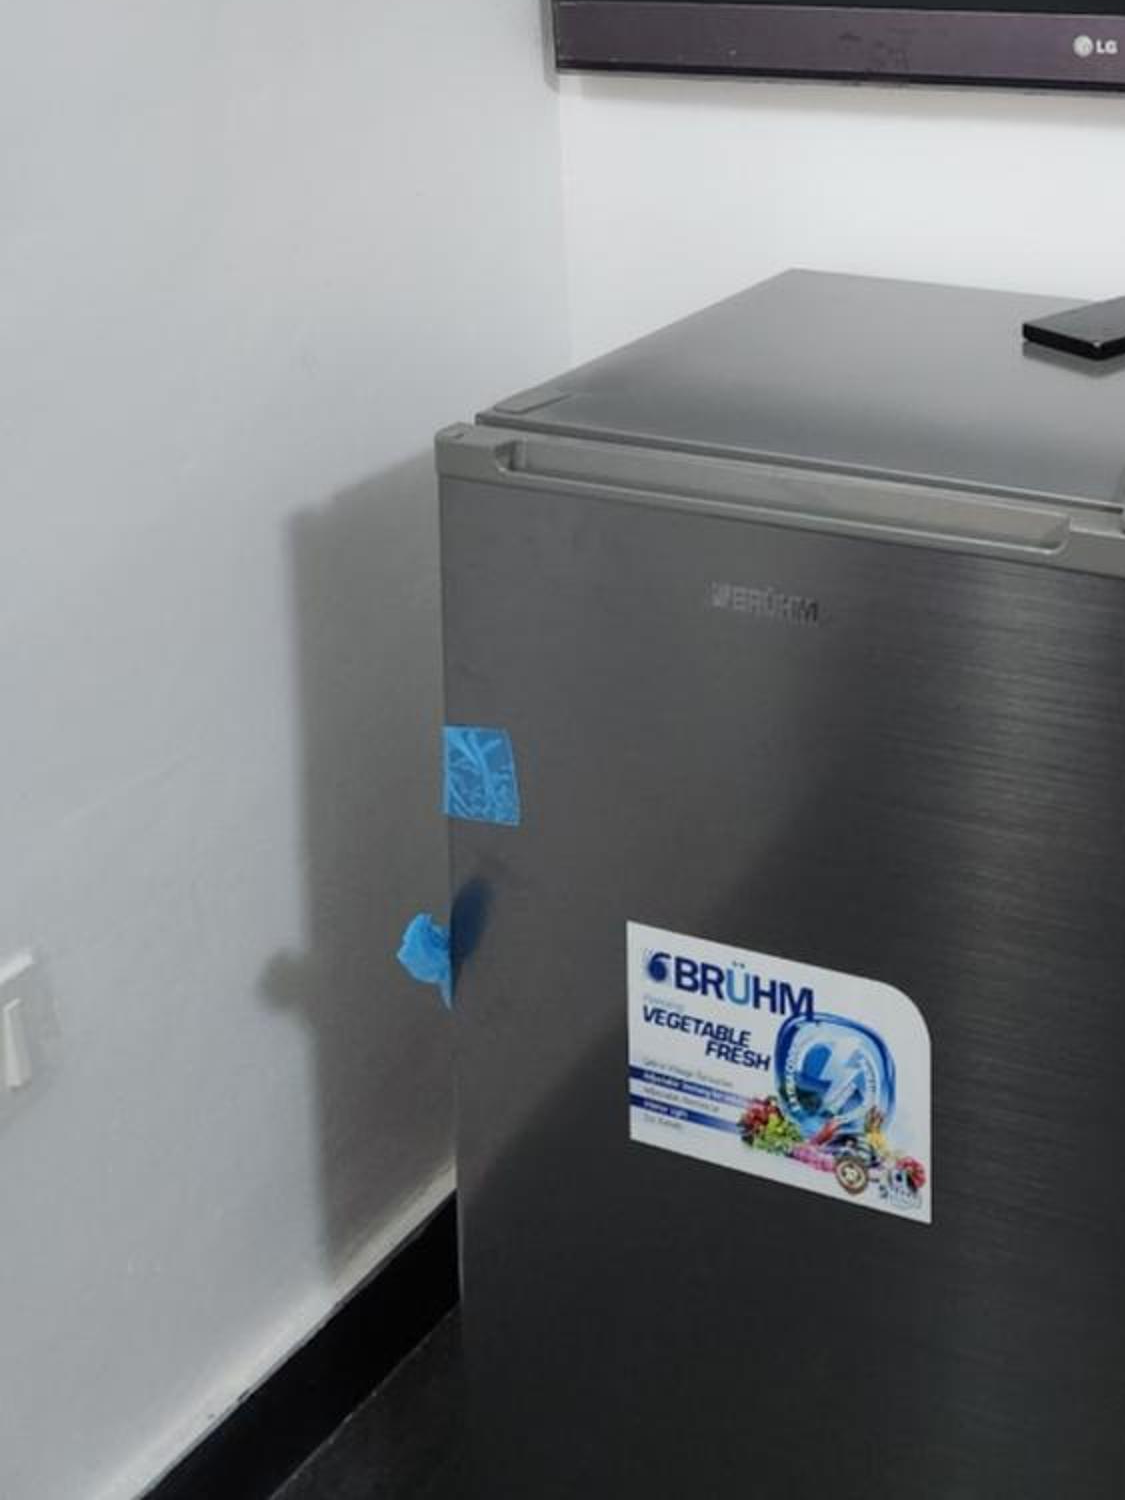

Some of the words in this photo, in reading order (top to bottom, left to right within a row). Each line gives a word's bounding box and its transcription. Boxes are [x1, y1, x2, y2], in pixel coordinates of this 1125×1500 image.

[1095, 38, 1118, 54] LG
[674, 956, 815, 1022] BRÜHM
[643, 1005, 752, 1049] VEGETABLE
[705, 1040, 771, 1072] FRESH
